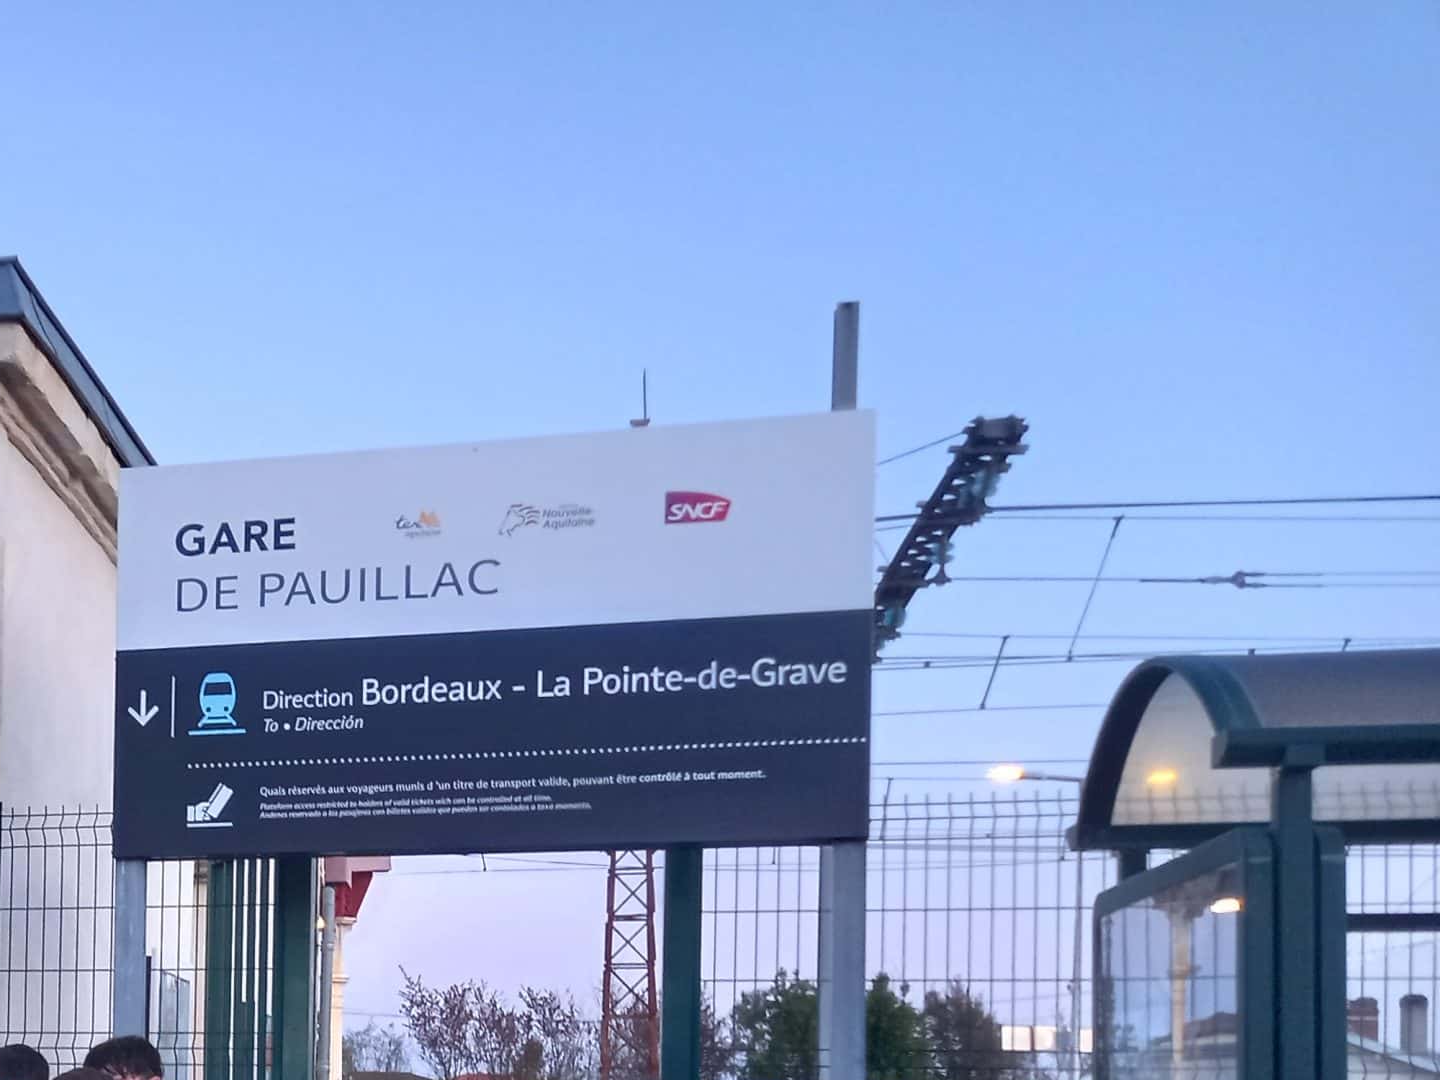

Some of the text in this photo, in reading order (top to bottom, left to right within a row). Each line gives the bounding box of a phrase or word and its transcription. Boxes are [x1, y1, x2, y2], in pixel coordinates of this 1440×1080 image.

[666, 501, 729, 521] SNCF
[175, 517, 296, 557] GARE
[176, 559, 501, 612] DE PAUILLAC
[262, 688, 354, 711] Direction
[361, 675, 502, 706] Bordeaux
[536, 669, 571, 698] La
[582, 657, 848, 696] Pointe-de-Grave
[263, 714, 364, 733] To Dirección
[260, 786, 286, 798] Quais
[288, 784, 326, 796] réservés
[328, 786, 344, 794] aux
[347, 783, 393, 795] voyageurs
[396, 781, 424, 792] munis
[453, 779, 474, 790] titre
[476, 779, 488, 789] de
[491, 778, 536, 789] transport
[538, 775, 571, 787] valide,
[573, 776, 614, 788] pouvant
[616, 773, 637, 785] être
[639, 771, 682, 783] contrôlé
[684, 771, 691, 781] à
[693, 771, 715, 781] tout
[718, 769, 767, 780] moment.
